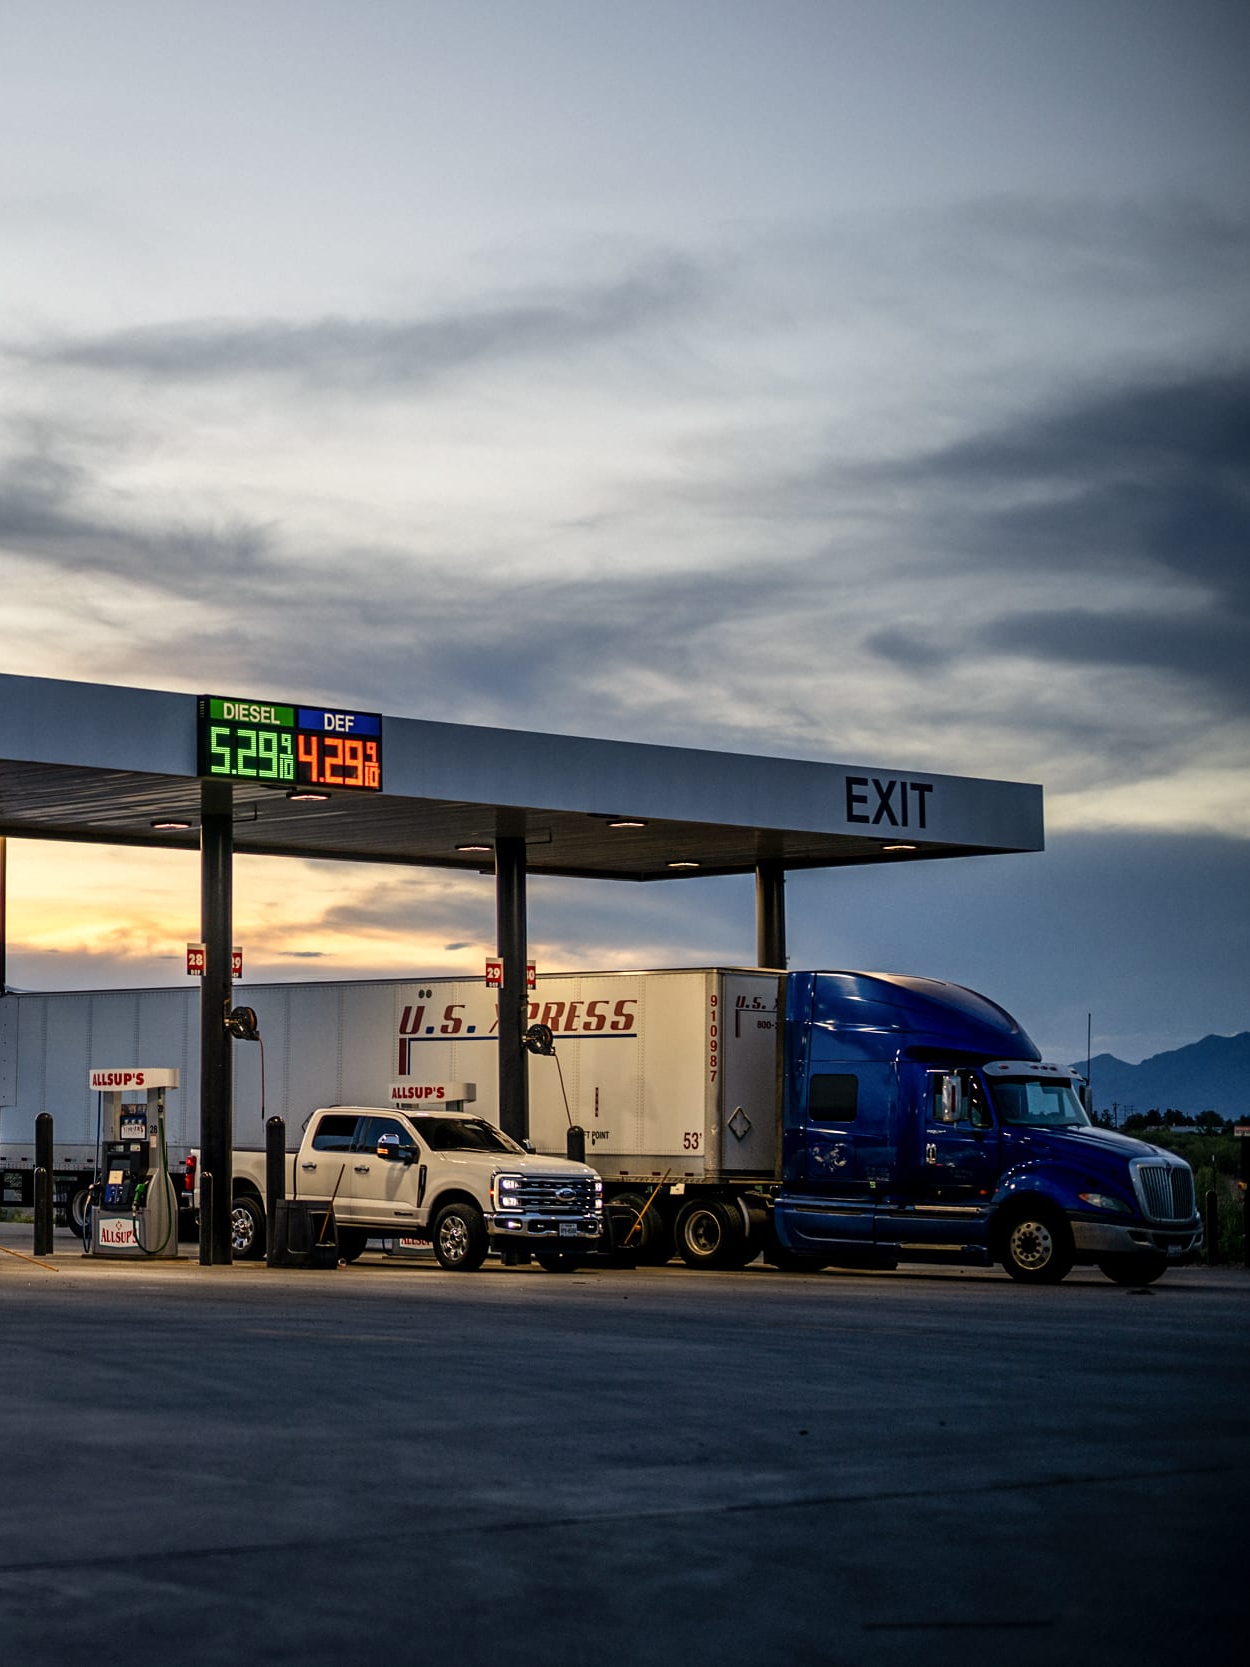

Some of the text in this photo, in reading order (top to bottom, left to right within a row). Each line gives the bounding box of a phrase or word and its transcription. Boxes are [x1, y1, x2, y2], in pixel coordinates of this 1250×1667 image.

[223, 702, 280, 725] DIESEL
[324, 713, 355, 732] DEF
[211, 726, 278, 778] 5.29
[298, 734, 364, 786] 4.29
[845, 776, 933, 829] EXIT
[188, 953, 203, 966] 28
[487, 967, 500, 979] 29
[527, 969, 535, 981] 0
[735, 995, 766, 1009] U.S.
[399, 1000, 637, 1034] U.S. PRESS
[710, 994, 718, 1082] 910987
[93, 1073, 144, 1086] ALLSUP'S
[392, 1087, 445, 1099] ALLSUP'S
[592, 1131, 609, 1139] POINT
[683, 1132, 702, 1149] 53'
[101, 1228, 138, 1243] ALLSUP
